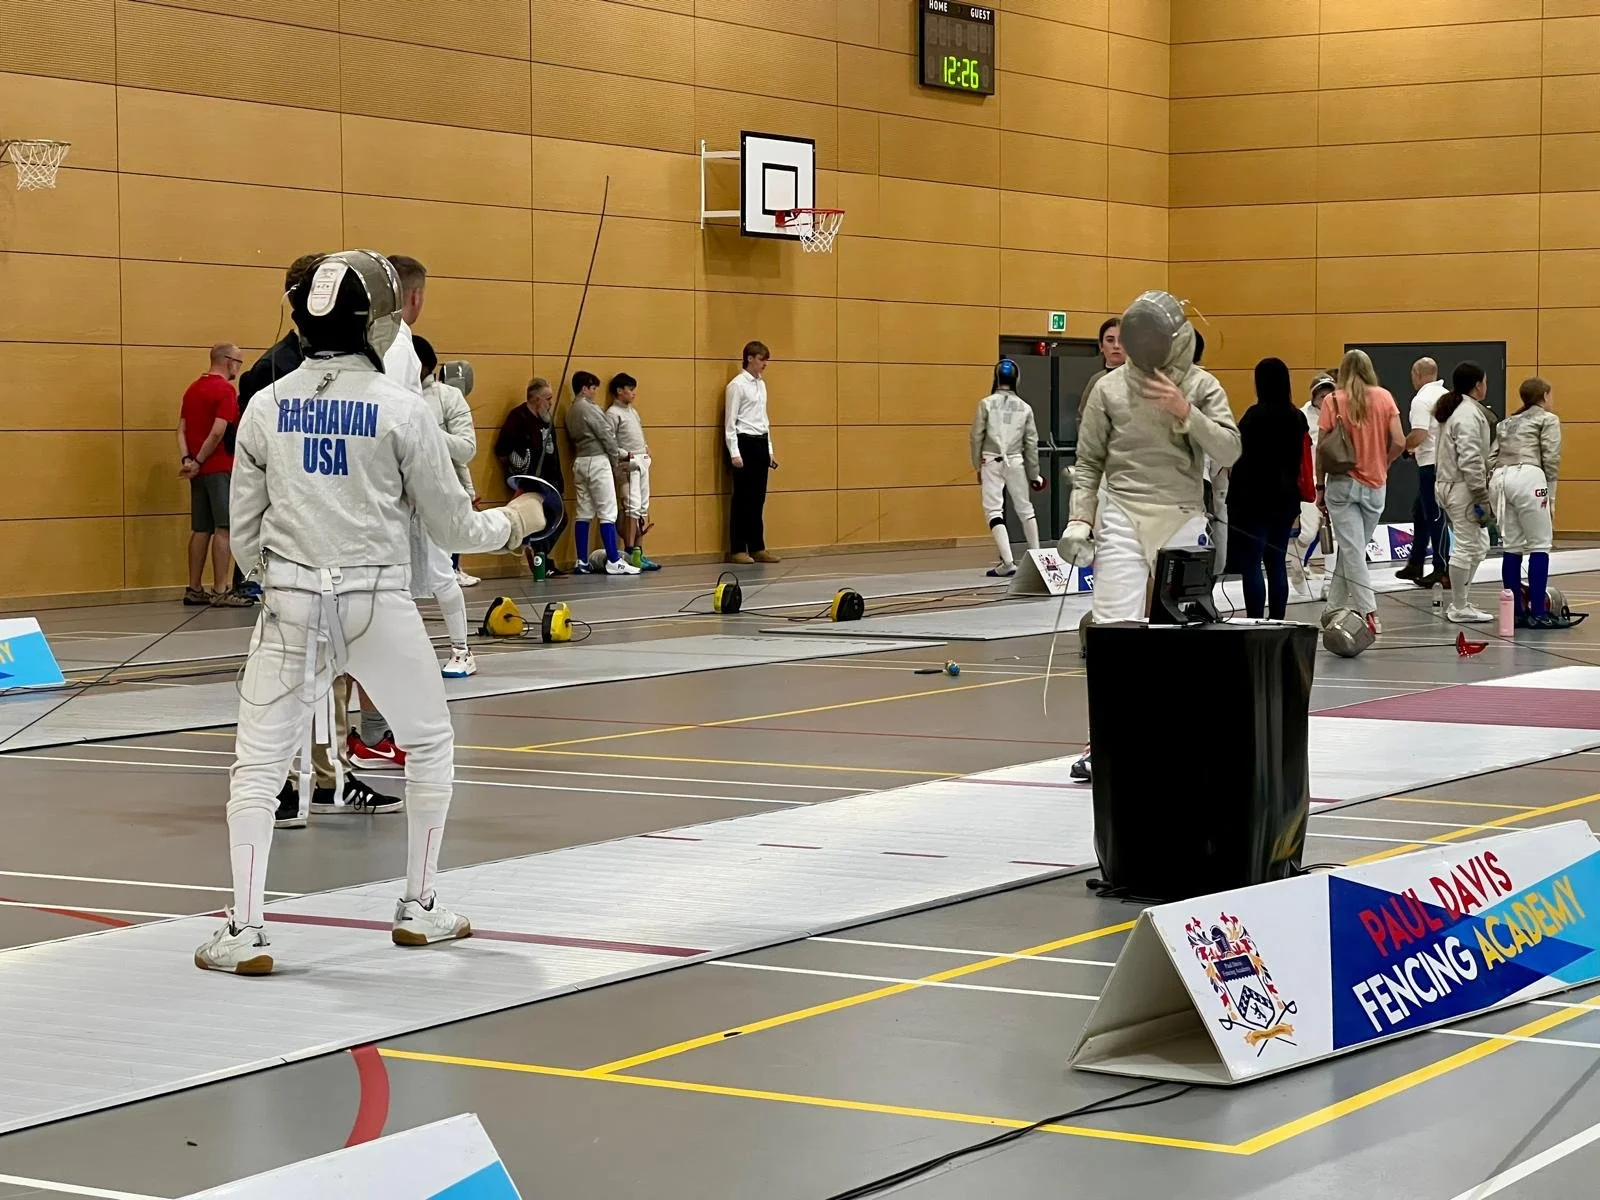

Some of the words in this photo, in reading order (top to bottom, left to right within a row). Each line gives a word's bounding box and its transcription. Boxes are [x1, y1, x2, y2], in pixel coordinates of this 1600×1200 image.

[928, 0, 948, 12] HOME
[970, 7, 991, 21] GUEST
[943, 56, 979, 89] 12:26
[277, 398, 379, 438] RAGHAVAN
[303, 437, 349, 476] USA
[1358, 888, 1444, 957] PAUL
[1429, 851, 1513, 920] DAVIS
[1352, 936, 1478, 1033] FENCING
[1472, 875, 1586, 971] ACADEMY
